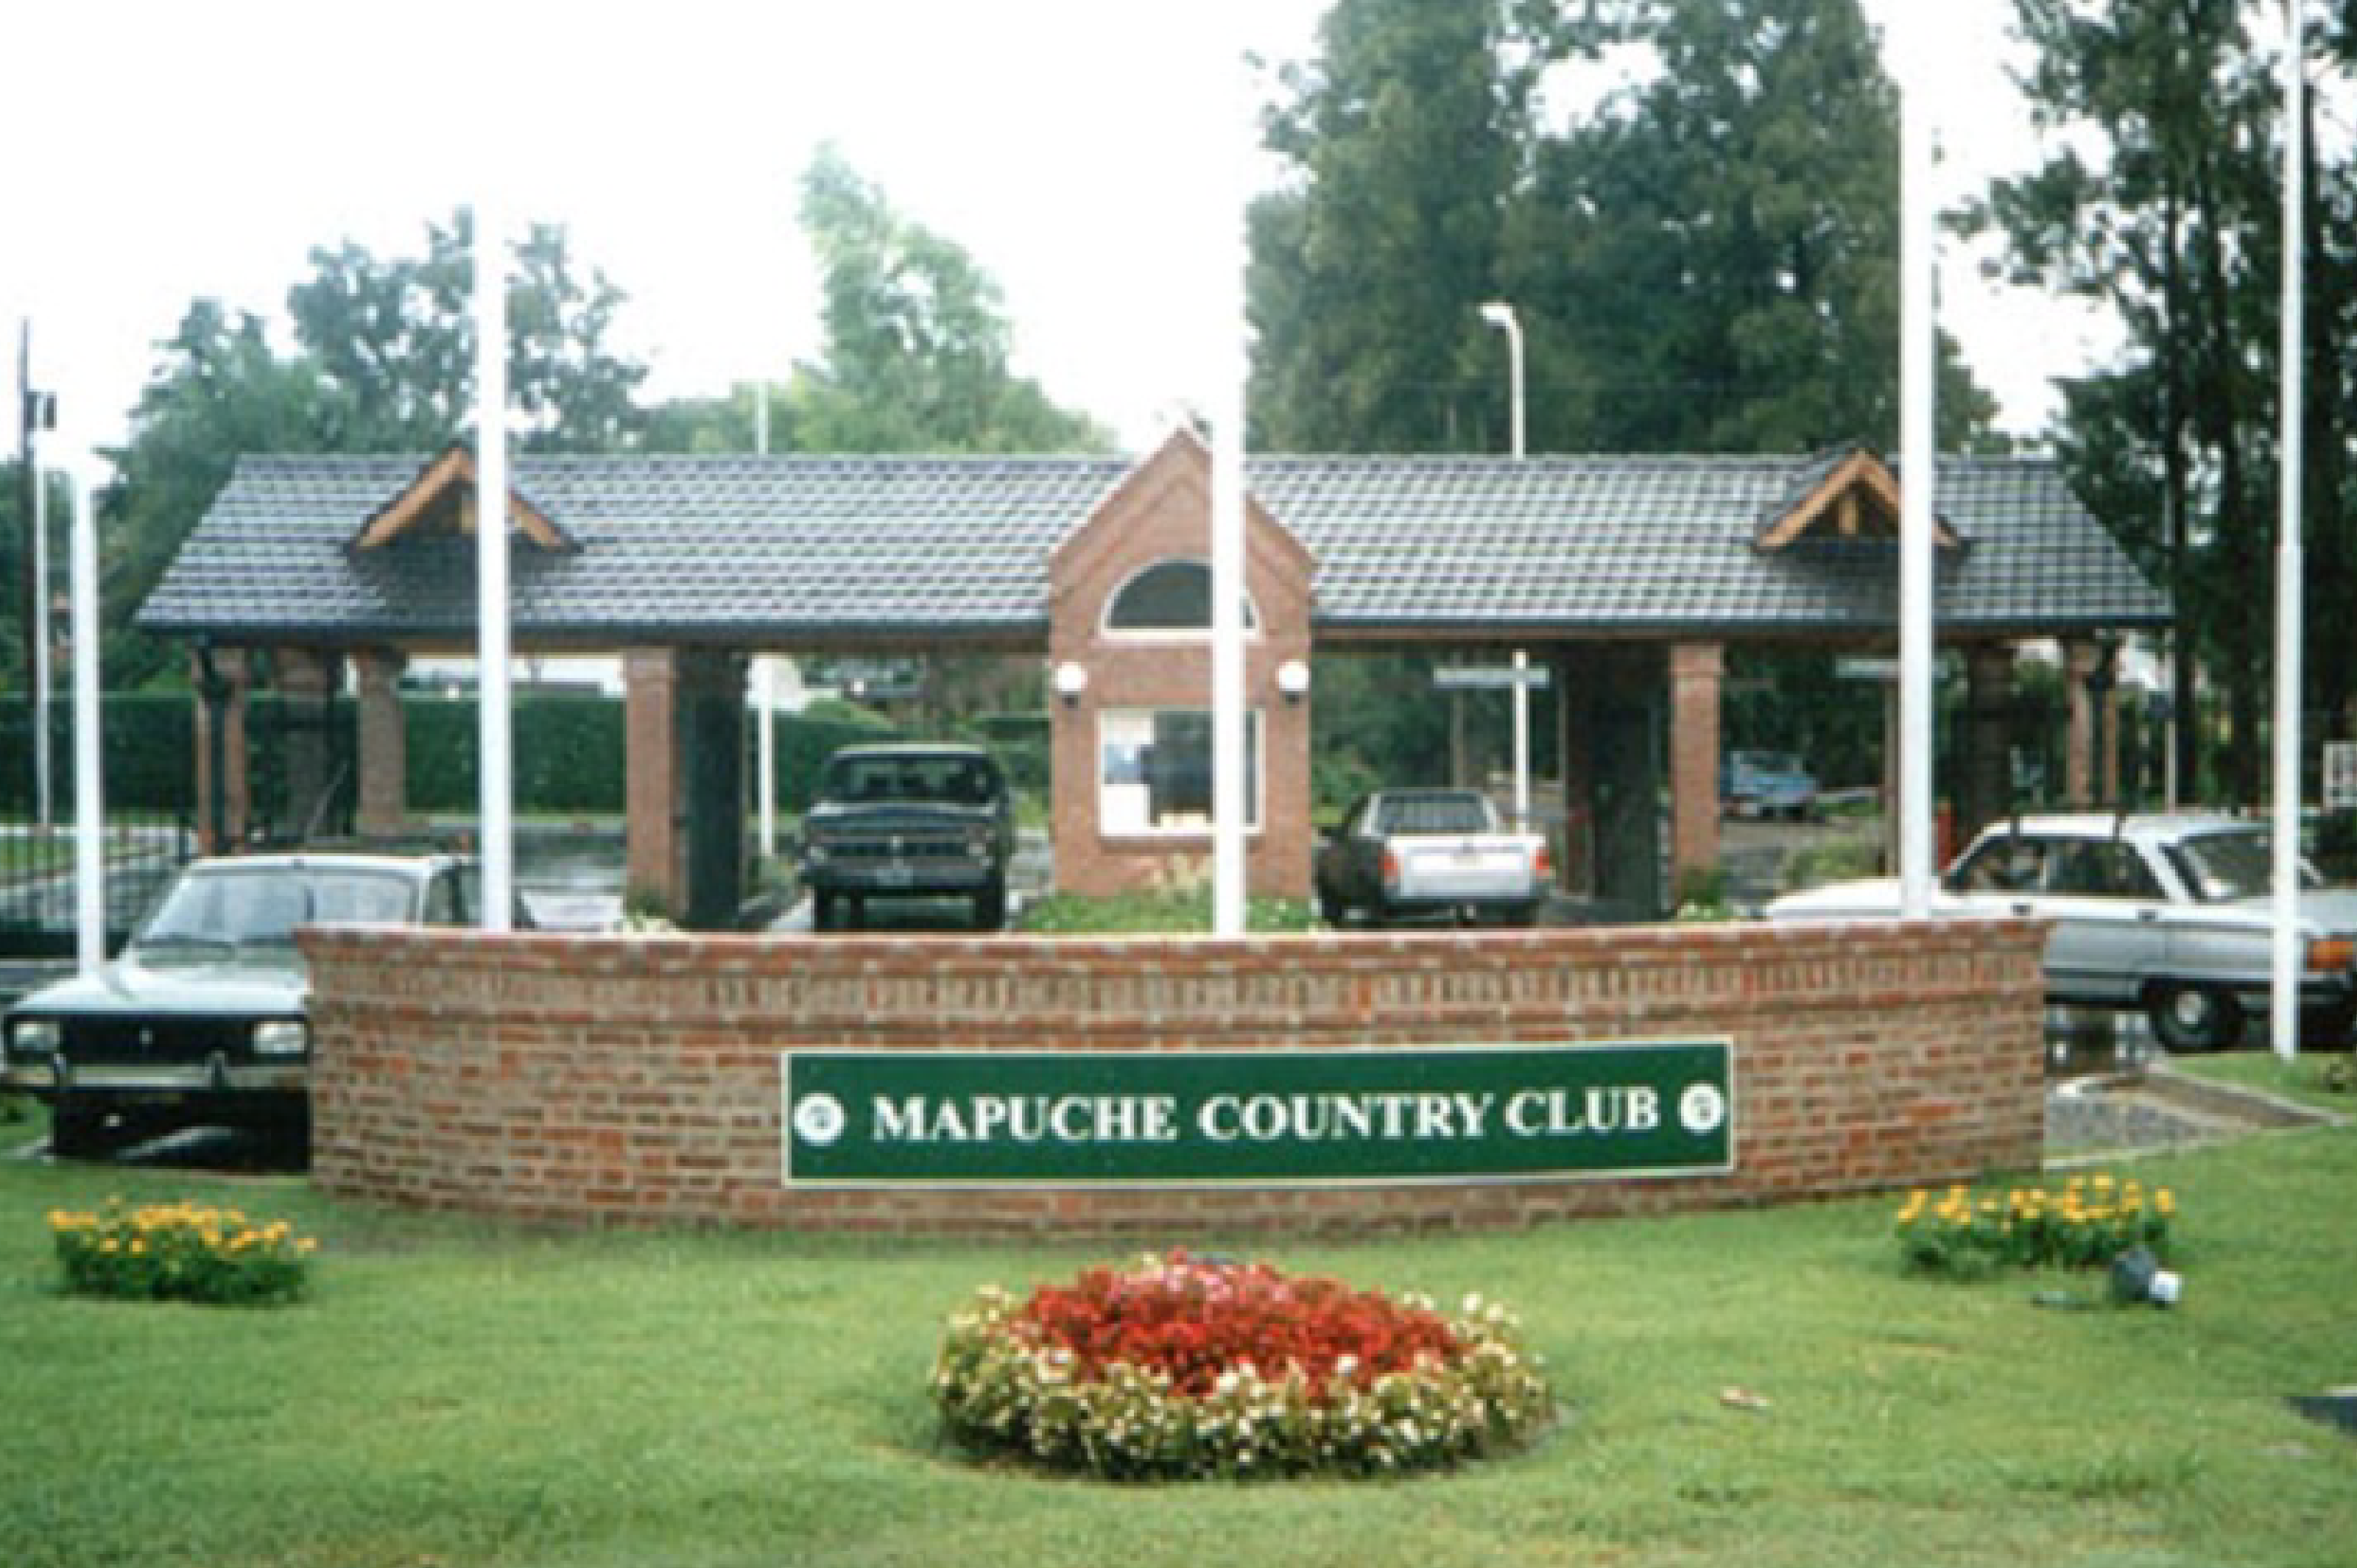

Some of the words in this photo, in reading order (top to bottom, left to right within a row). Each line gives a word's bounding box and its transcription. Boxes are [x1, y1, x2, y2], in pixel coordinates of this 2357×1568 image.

[873, 1095, 1179, 1141] MAPUCHE
[1197, 1092, 1493, 1140] COUNTRY
[1505, 1086, 1660, 1136] CLUB
